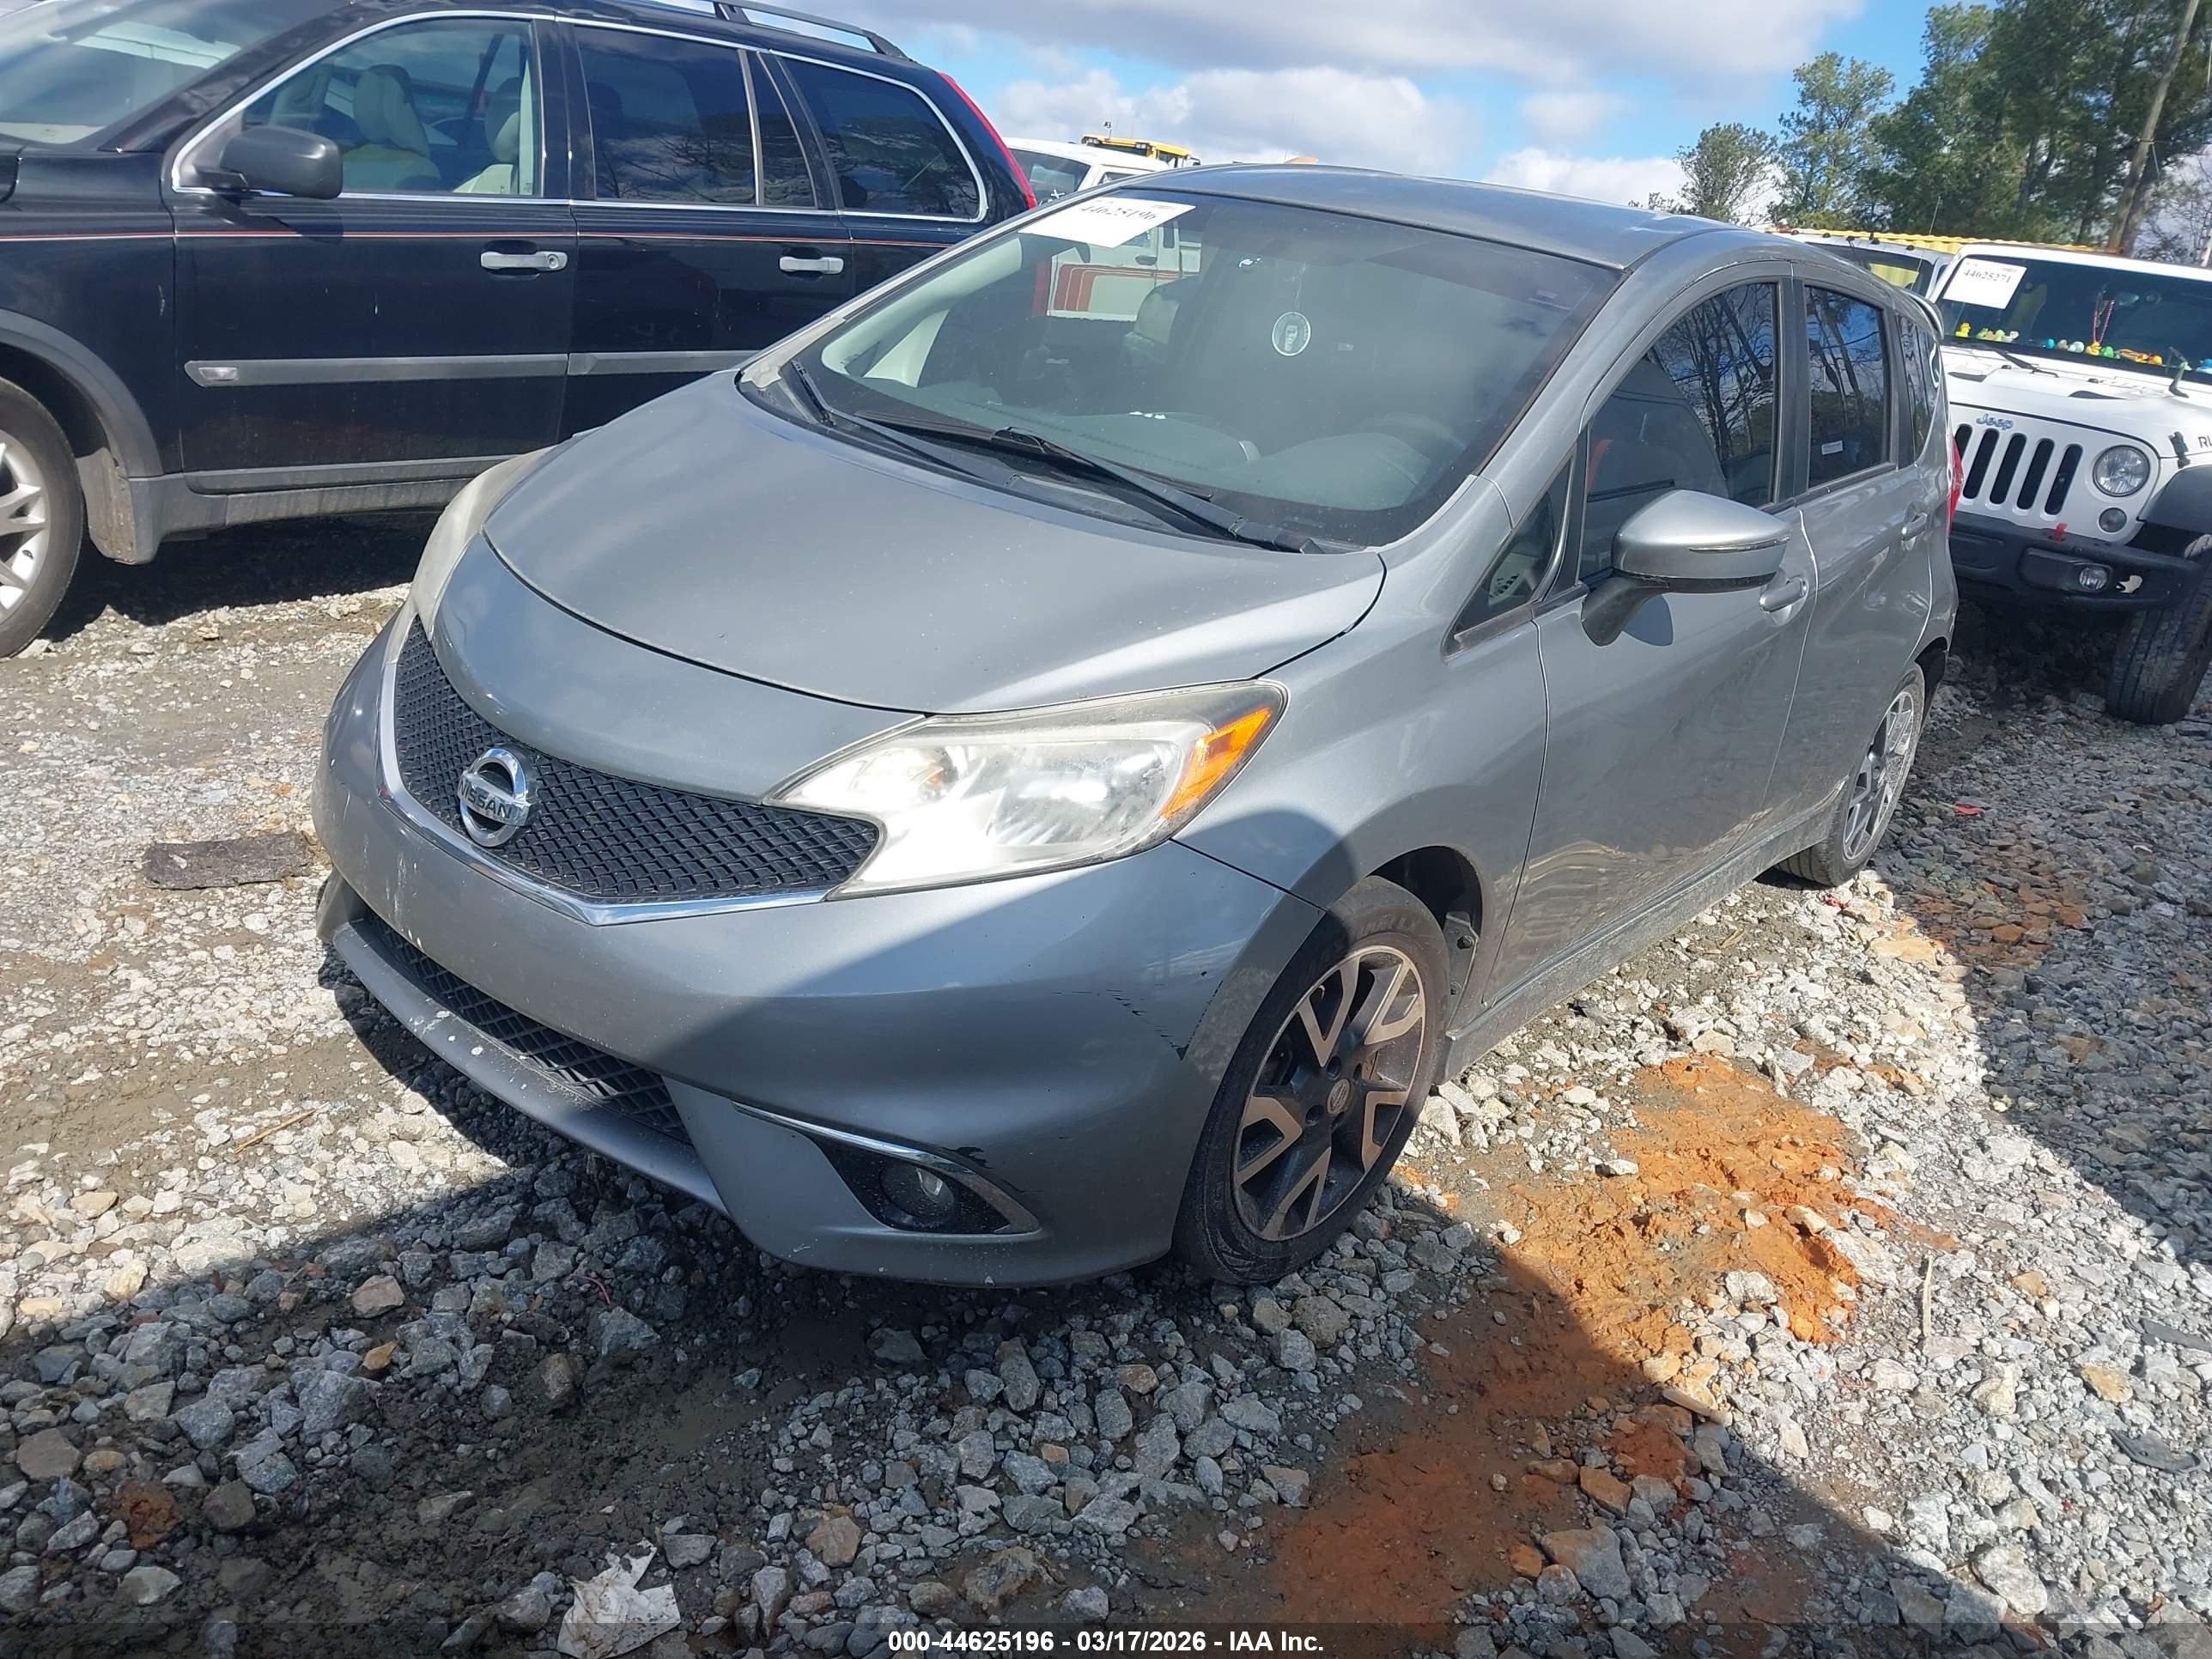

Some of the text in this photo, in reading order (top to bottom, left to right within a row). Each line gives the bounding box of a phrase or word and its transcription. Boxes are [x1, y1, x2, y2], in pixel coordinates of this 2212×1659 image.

[1079, 204, 1157, 221] 44625196
[1963, 268, 2012, 283] 44625271
[1976, 413, 2014, 431] Jeep
[459, 777, 514, 819] NISSAN
